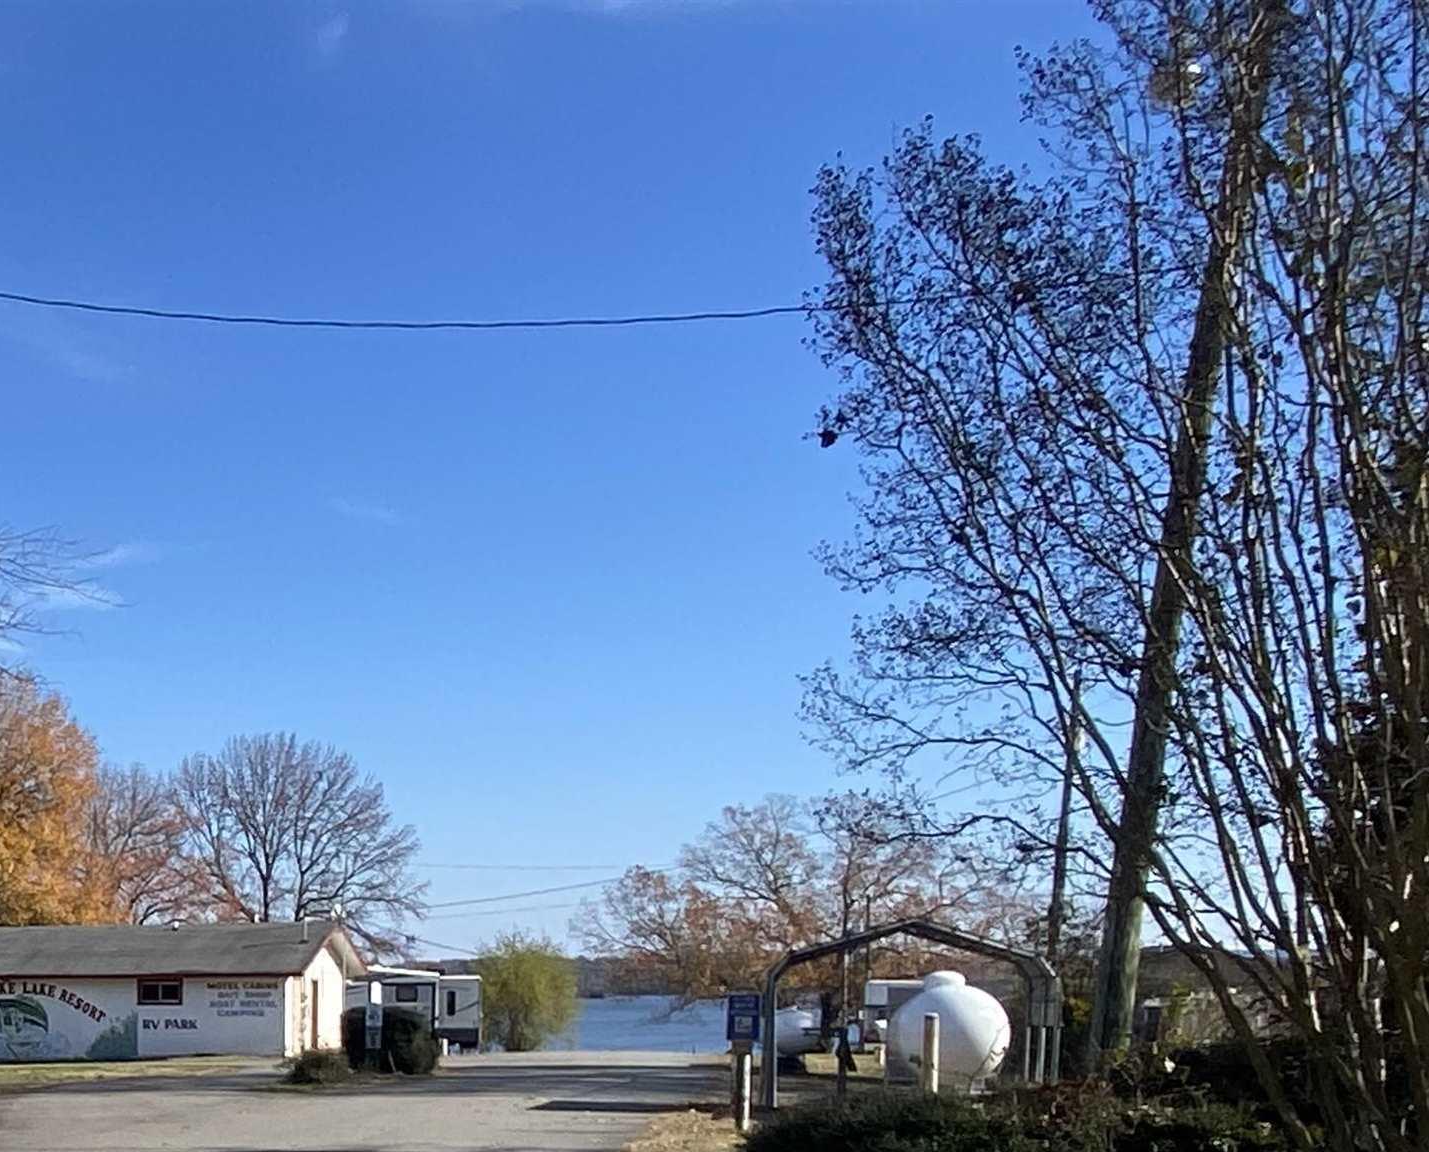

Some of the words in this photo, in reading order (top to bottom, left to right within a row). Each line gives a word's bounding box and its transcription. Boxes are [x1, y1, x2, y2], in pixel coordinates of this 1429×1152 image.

[23, 981, 56, 998] LAKE
[58, 989, 107, 1023] RESORT
[142, 1019, 160, 1030] RV
[164, 1019, 198, 1030] PARK
